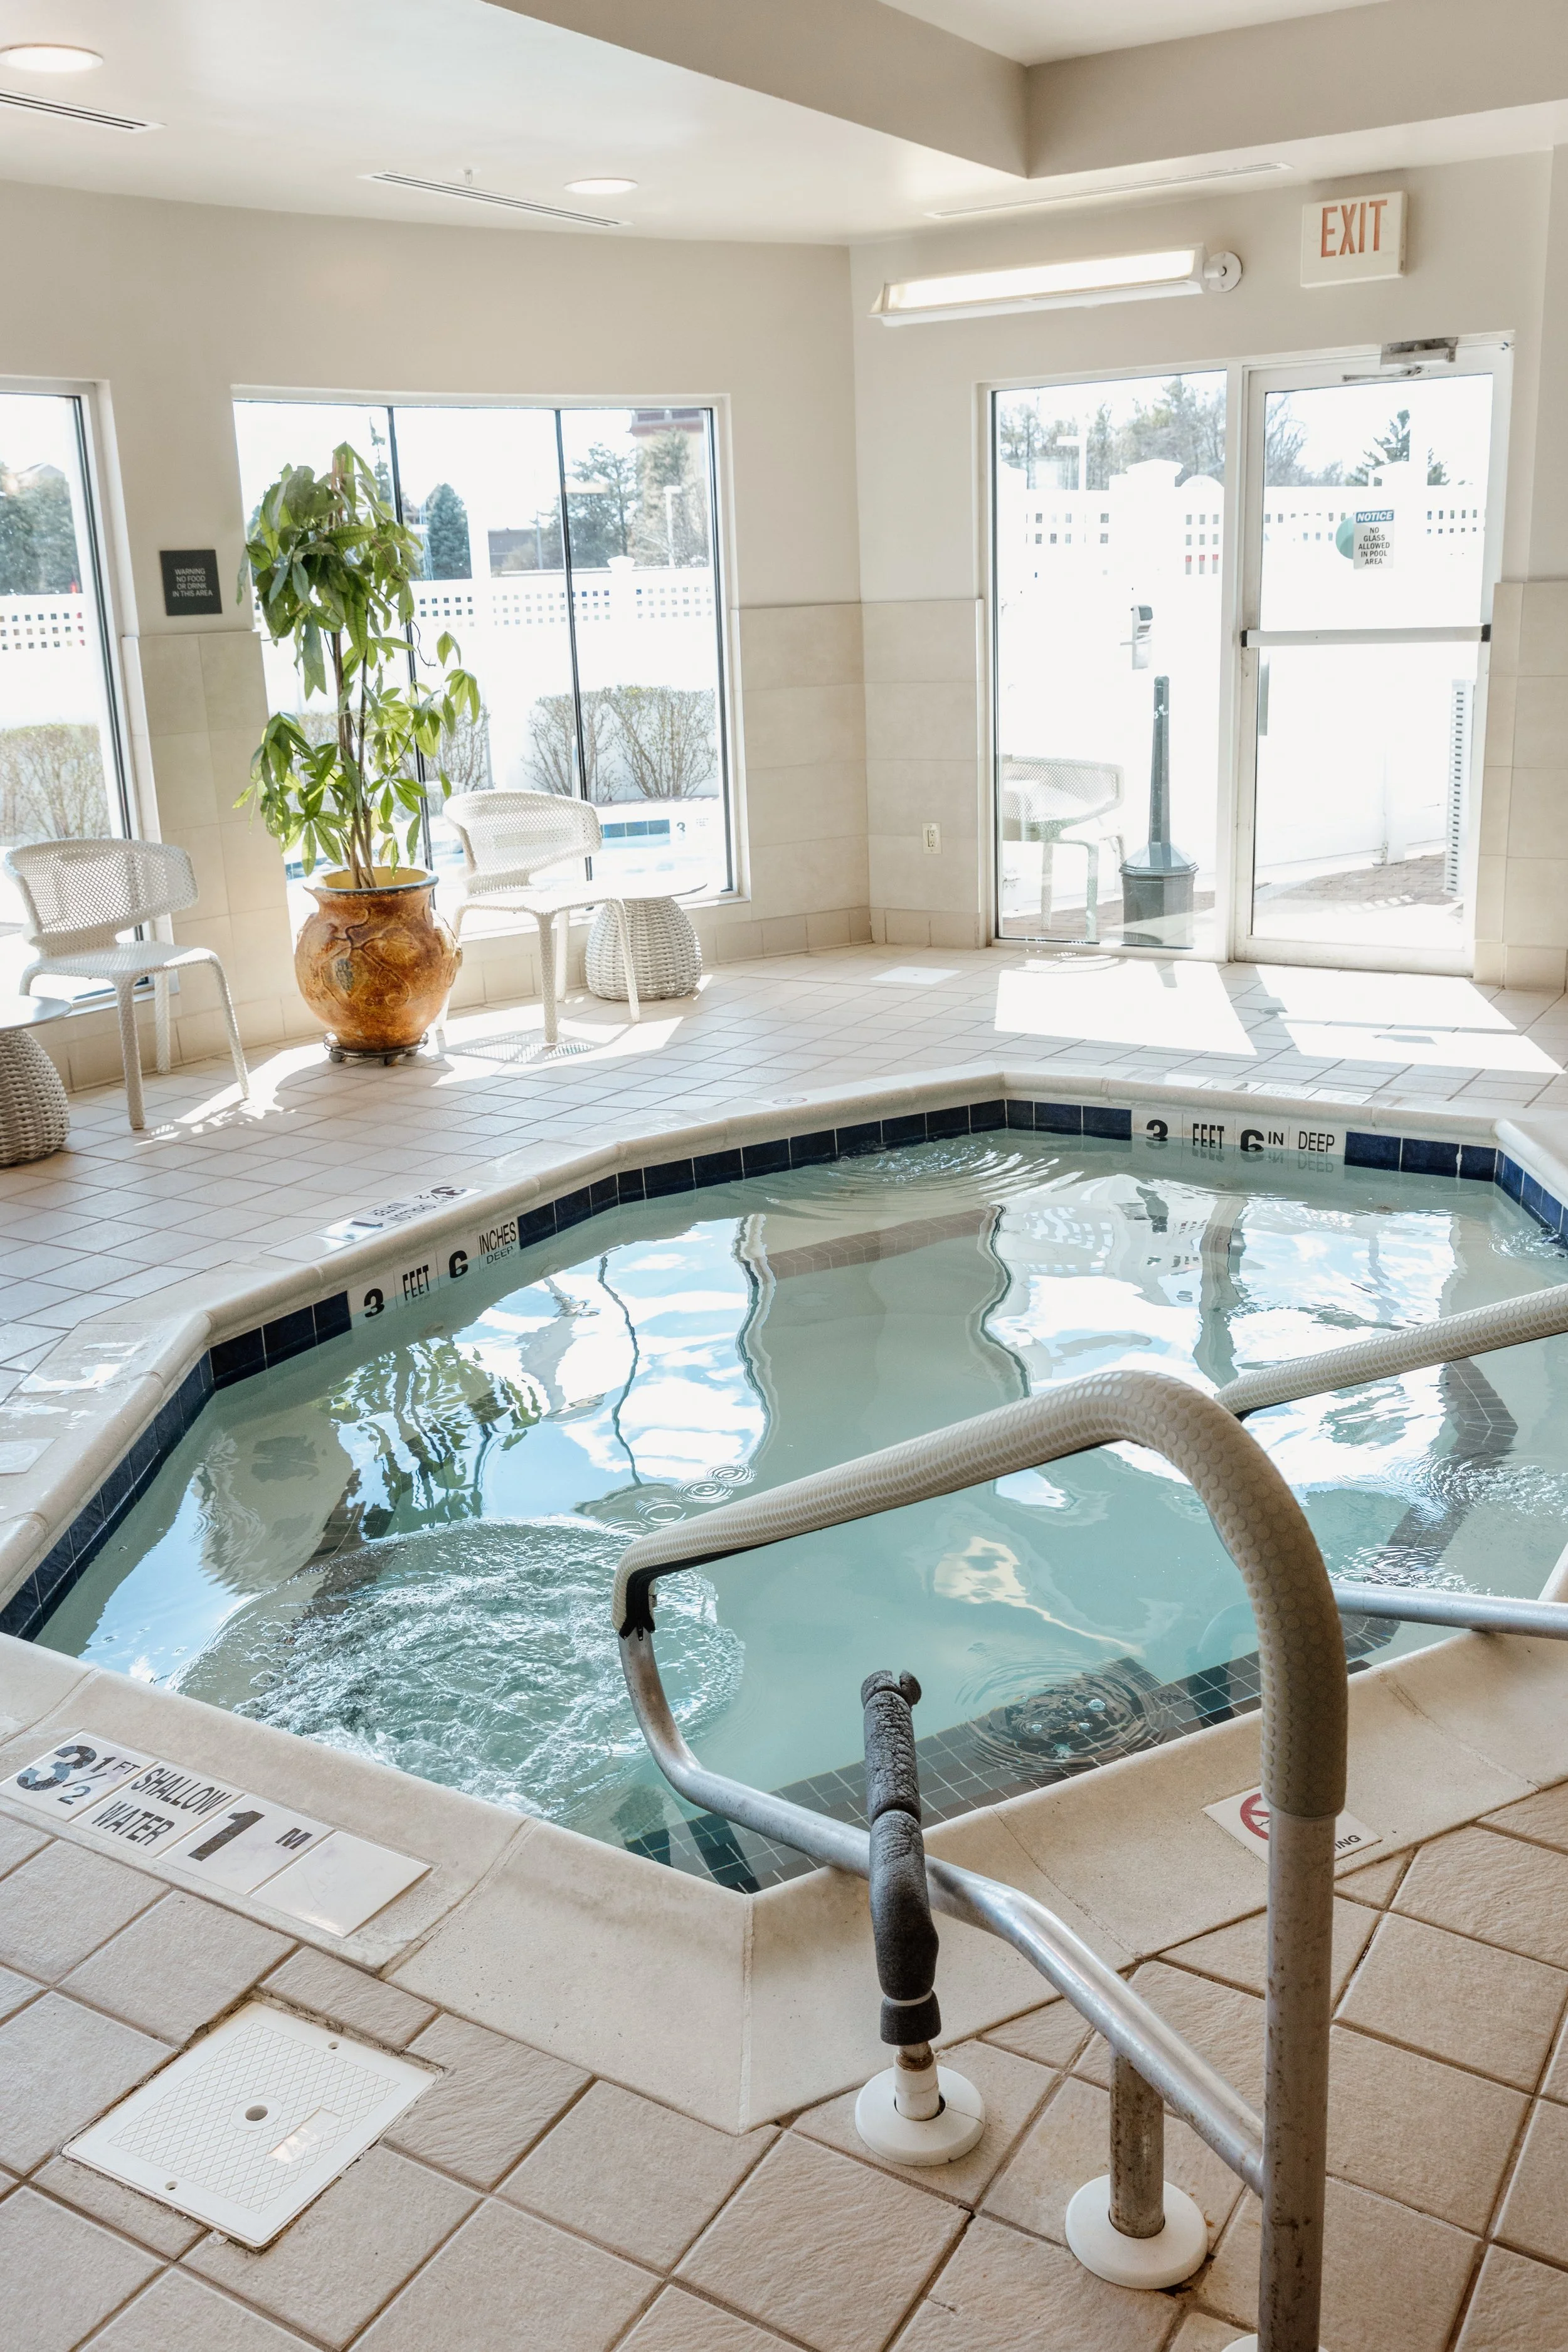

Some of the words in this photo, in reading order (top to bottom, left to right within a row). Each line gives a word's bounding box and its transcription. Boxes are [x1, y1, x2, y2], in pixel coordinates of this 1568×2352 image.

[1321, 199, 1387, 258] EXIT
[1357, 511, 1392, 521] NOTICE
[1358, 542, 1390, 550] ALLOWED
[1146, 1119, 1168, 1142] 3
[1192, 1123, 1224, 1149] FEET
[1240, 1129, 1264, 1152] 6
[1268, 1131, 1284, 1146] IN
[1298, 1131, 1335, 1153] DEEP
[430, 1187, 467, 1195] 3
[369, 1202, 410, 1216] WATER
[388, 1203, 437, 1222] SHALLOW
[350, 1221, 384, 1229] 1
[479, 1221, 516, 1255] INCHES
[486, 1246, 513, 1264] DEEP
[364, 1288, 384, 1318] 3
[402, 1264, 430, 1301] FEET
[448, 1250, 469, 1278] 6
[16, 1745, 98, 1791] 3
[112, 1760, 141, 1776] FT
[130, 1767, 234, 1816] SHALLOW
[91, 1800, 176, 1846] WATER
[188, 1809, 265, 1862] 1
[275, 1827, 313, 1850] M
[1335, 1835, 1362, 1851] ING
